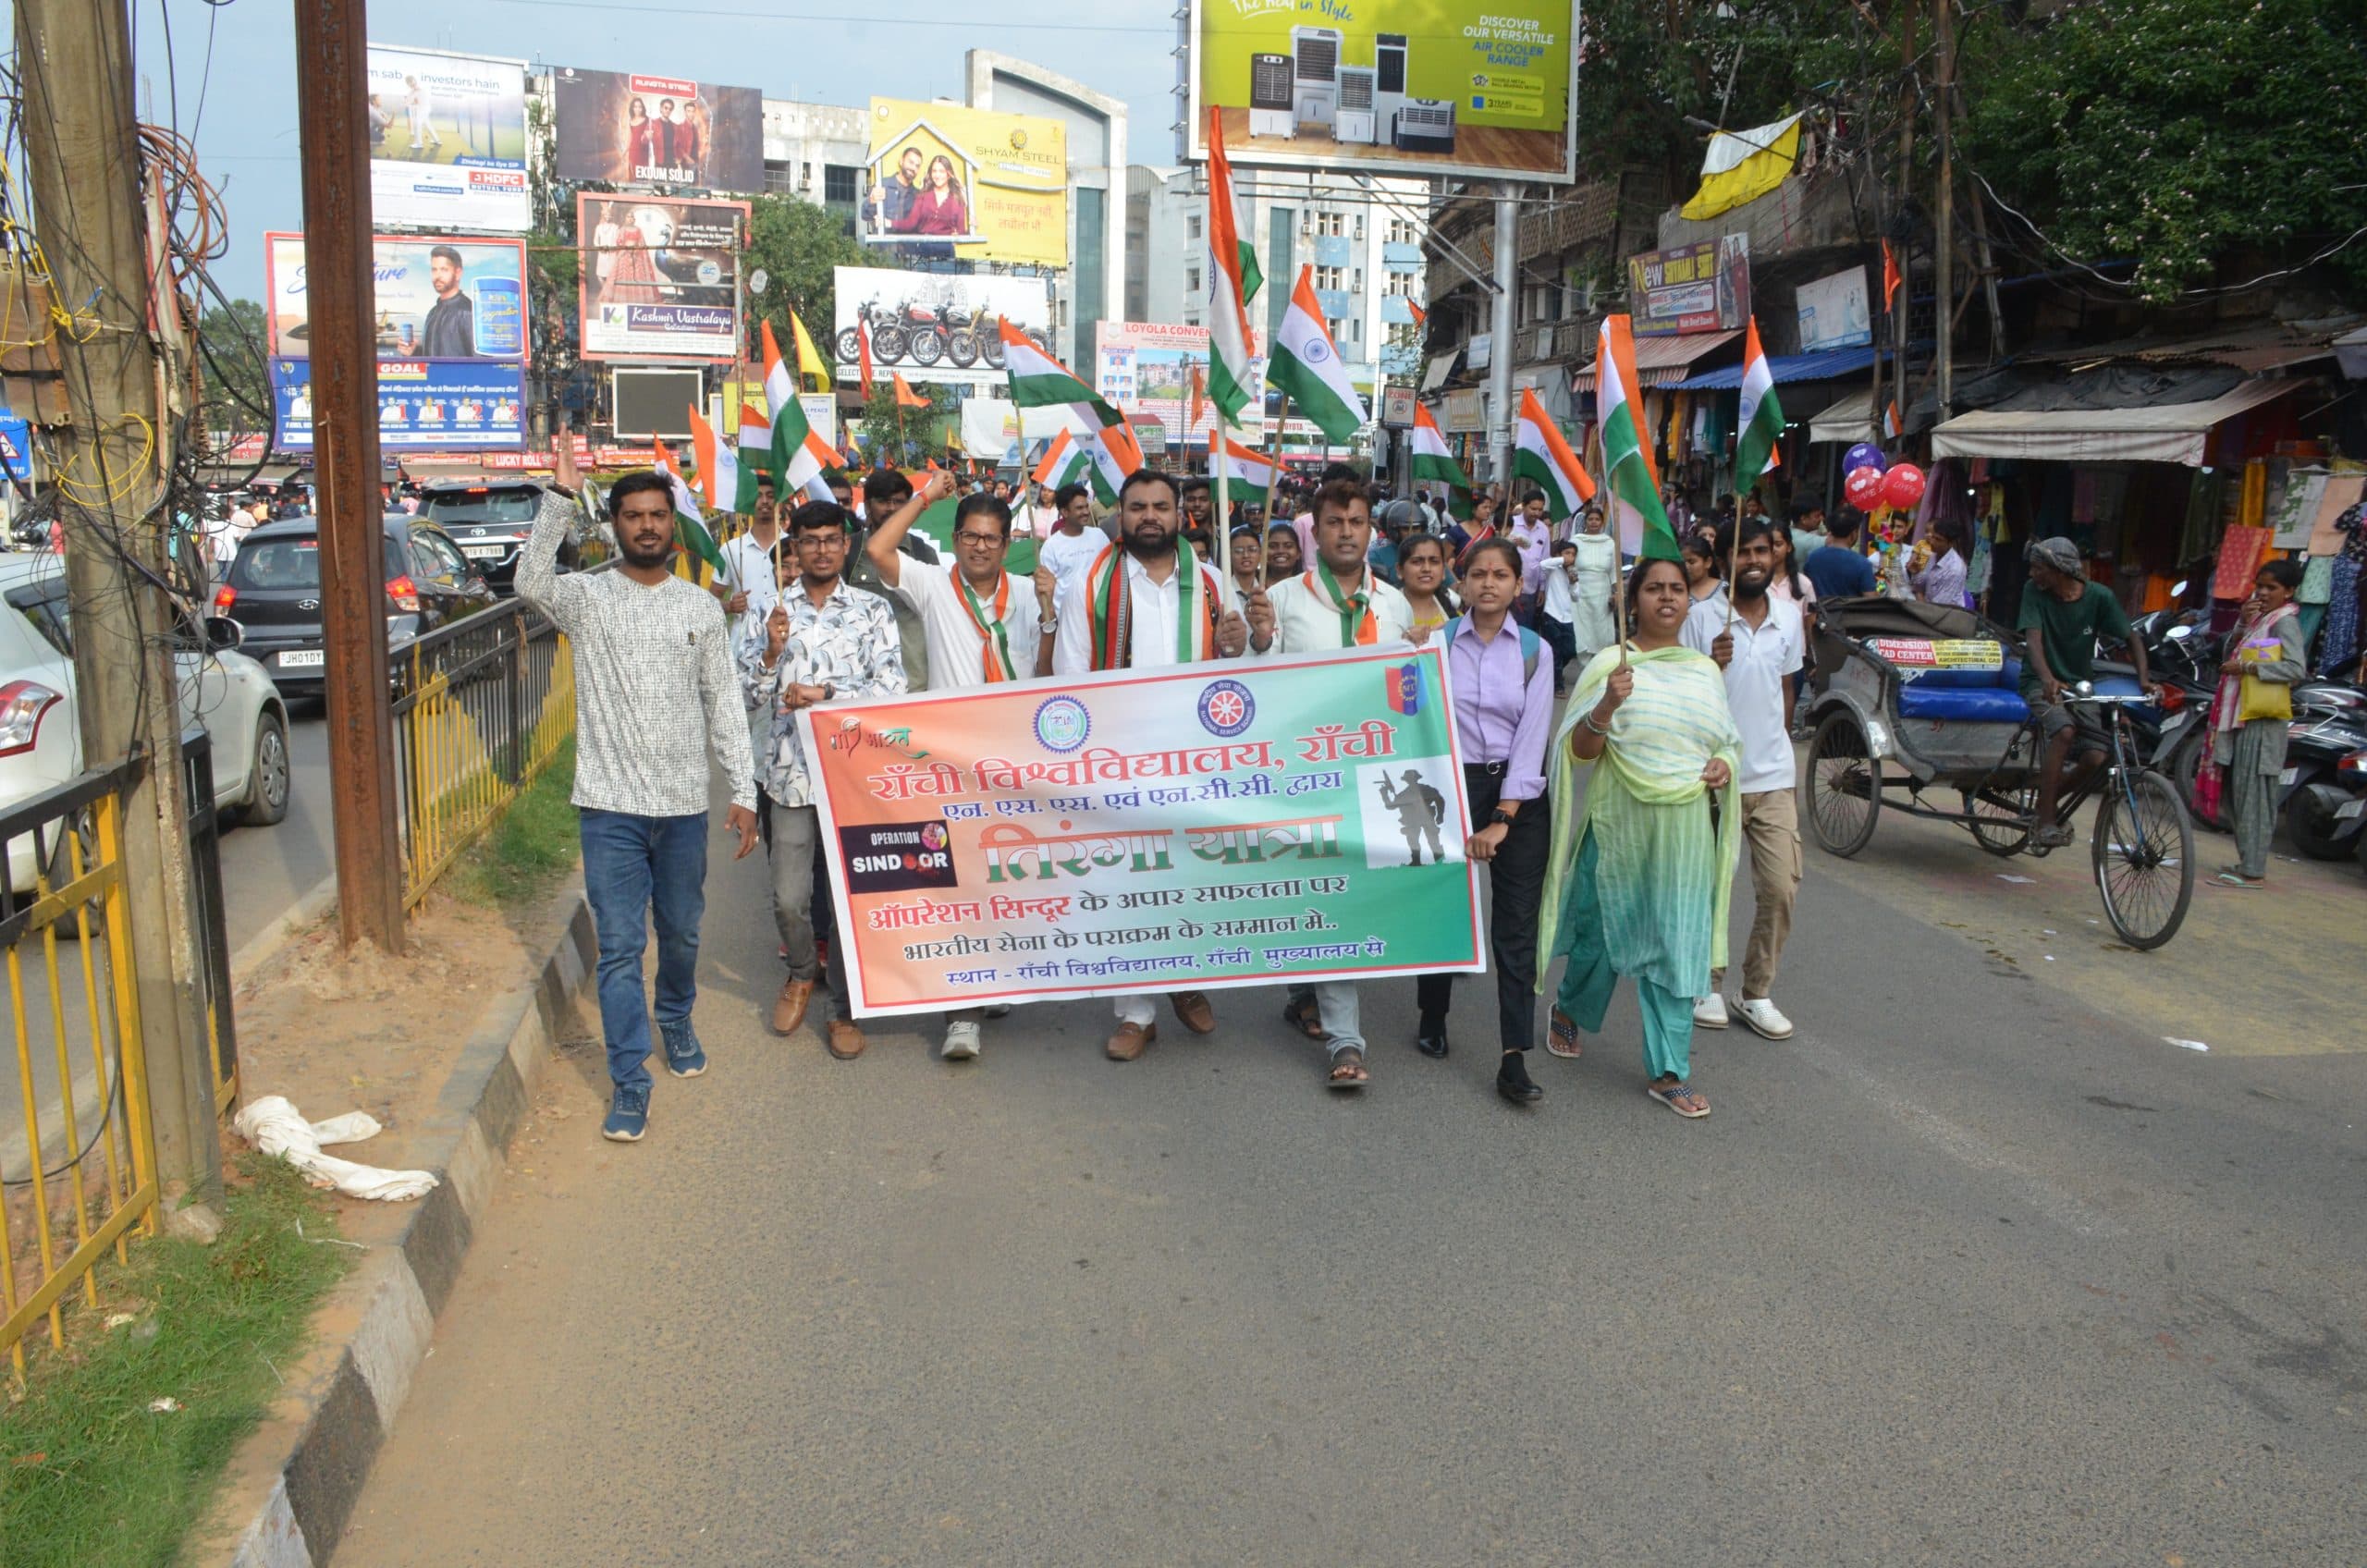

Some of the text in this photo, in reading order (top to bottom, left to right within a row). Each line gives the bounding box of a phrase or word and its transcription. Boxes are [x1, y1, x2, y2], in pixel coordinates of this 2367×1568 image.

[1479, 15, 1539, 31] DISCOVER
[1463, 26, 1554, 44] OUR VERSATILE
[1473, 41, 1544, 56] AIR COOLER
[1487, 54, 1528, 67] RANGE
[382, 68, 403, 80] sab
[421, 72, 472, 87] investors
[475, 78, 500, 90] hain
[975, 146, 1061, 165] SHYAM STEEL
[484, 173, 520, 185] HDFC
[635, 165, 694, 182] EKDUM SOLID
[1628, 258, 1663, 294] New
[632, 307, 731, 333] Kashmir Vastralaya
[1125, 324, 1210, 338] LOYOLA CONVEN
[380, 363, 420, 374] GOAL
[496, 454, 542, 467] LUCKY ROLL
[1879, 639, 1931, 650] DIMENSION
[286, 652, 322, 664] JH01DY
[1880, 649, 1933, 660] CAD CENTER
[867, 720, 1396, 800] राँची विश्वविद्यालय, राँची
[942, 804, 988, 821] एन.
[996, 800, 1043, 817] एस.
[1049, 796, 1098, 814] एस.
[1105, 786, 1142, 808] एवं
[1285, 770, 1344, 798] द्वारा
[871, 830, 920, 846] OPERATION
[978, 814, 1343, 883] तिरंगा यात्रा
[868, 875, 1348, 929] ऑपरेशन सिन्दूर के अपार सफलता पर
[903, 933, 989, 962] भारतीय
[996, 931, 1047, 953] सेना
[1052, 927, 1079, 949] के
[1084, 925, 1171, 946] पराक्रम
[1178, 918, 1205, 939] के
[1211, 915, 1297, 937] सम्मान
[946, 968, 997, 986] स्थान
[1017, 961, 1061, 980] राँची
[1065, 955, 1201, 977] विश्वविद्यालय,
[1206, 947, 1252, 967] राँची
[1263, 942, 1359, 969] मुख्यालय
[1364, 936, 1385, 956] से
